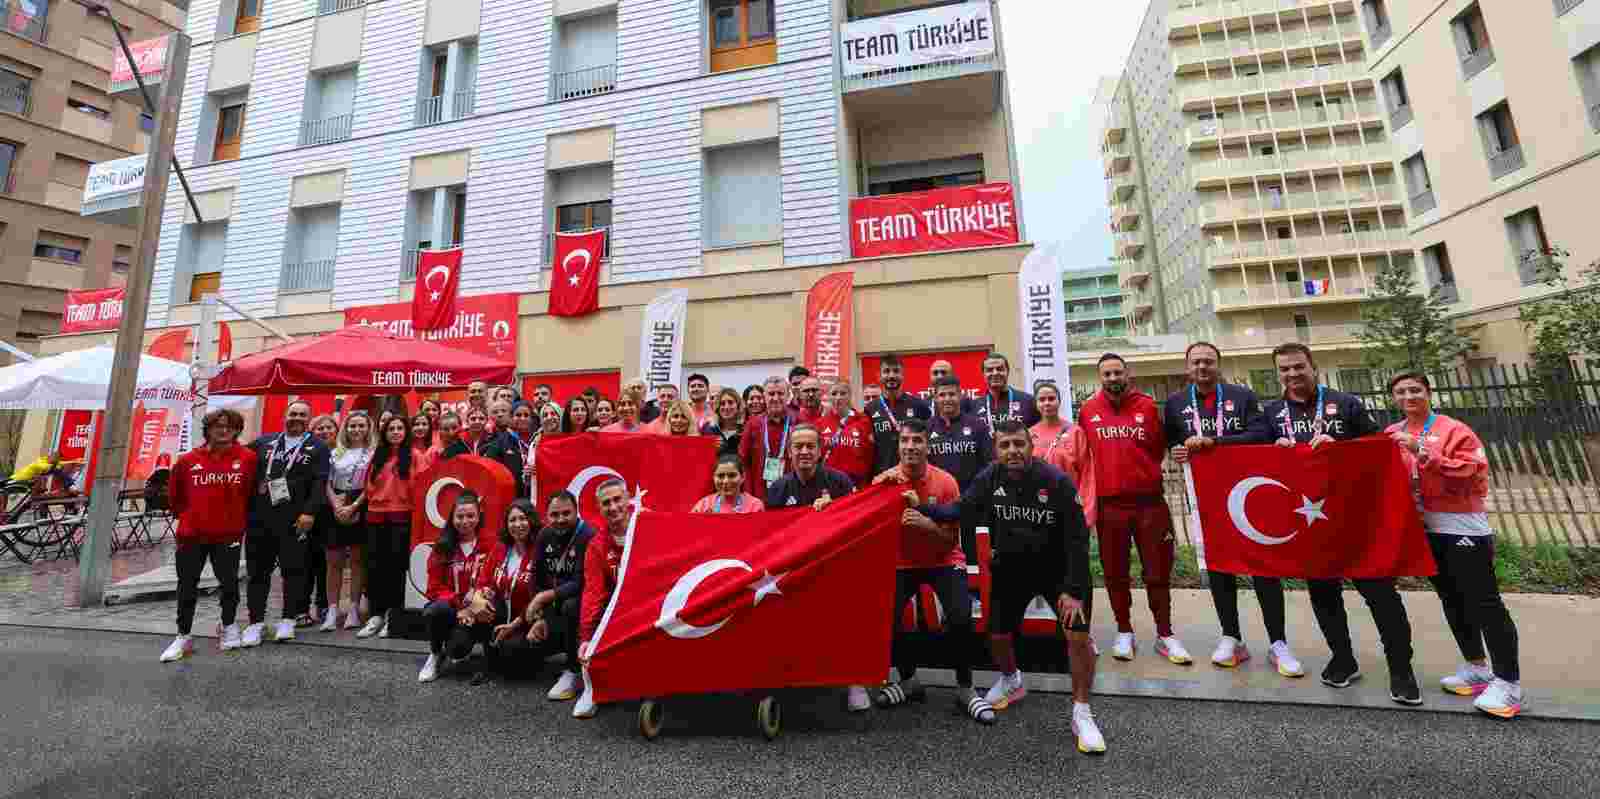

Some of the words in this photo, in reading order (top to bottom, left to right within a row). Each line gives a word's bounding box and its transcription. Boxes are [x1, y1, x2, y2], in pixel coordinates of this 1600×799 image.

[842, 33, 899, 61] TEAM
[905, 17, 989, 51] TÜRKİYE
[855, 213, 917, 244] TEAM
[922, 199, 1012, 236] TÜRKİYE
[1026, 284, 1054, 372] TÜRKİYE
[371, 371, 405, 385] TEAM
[408, 368, 452, 386] TÜRKİYE
